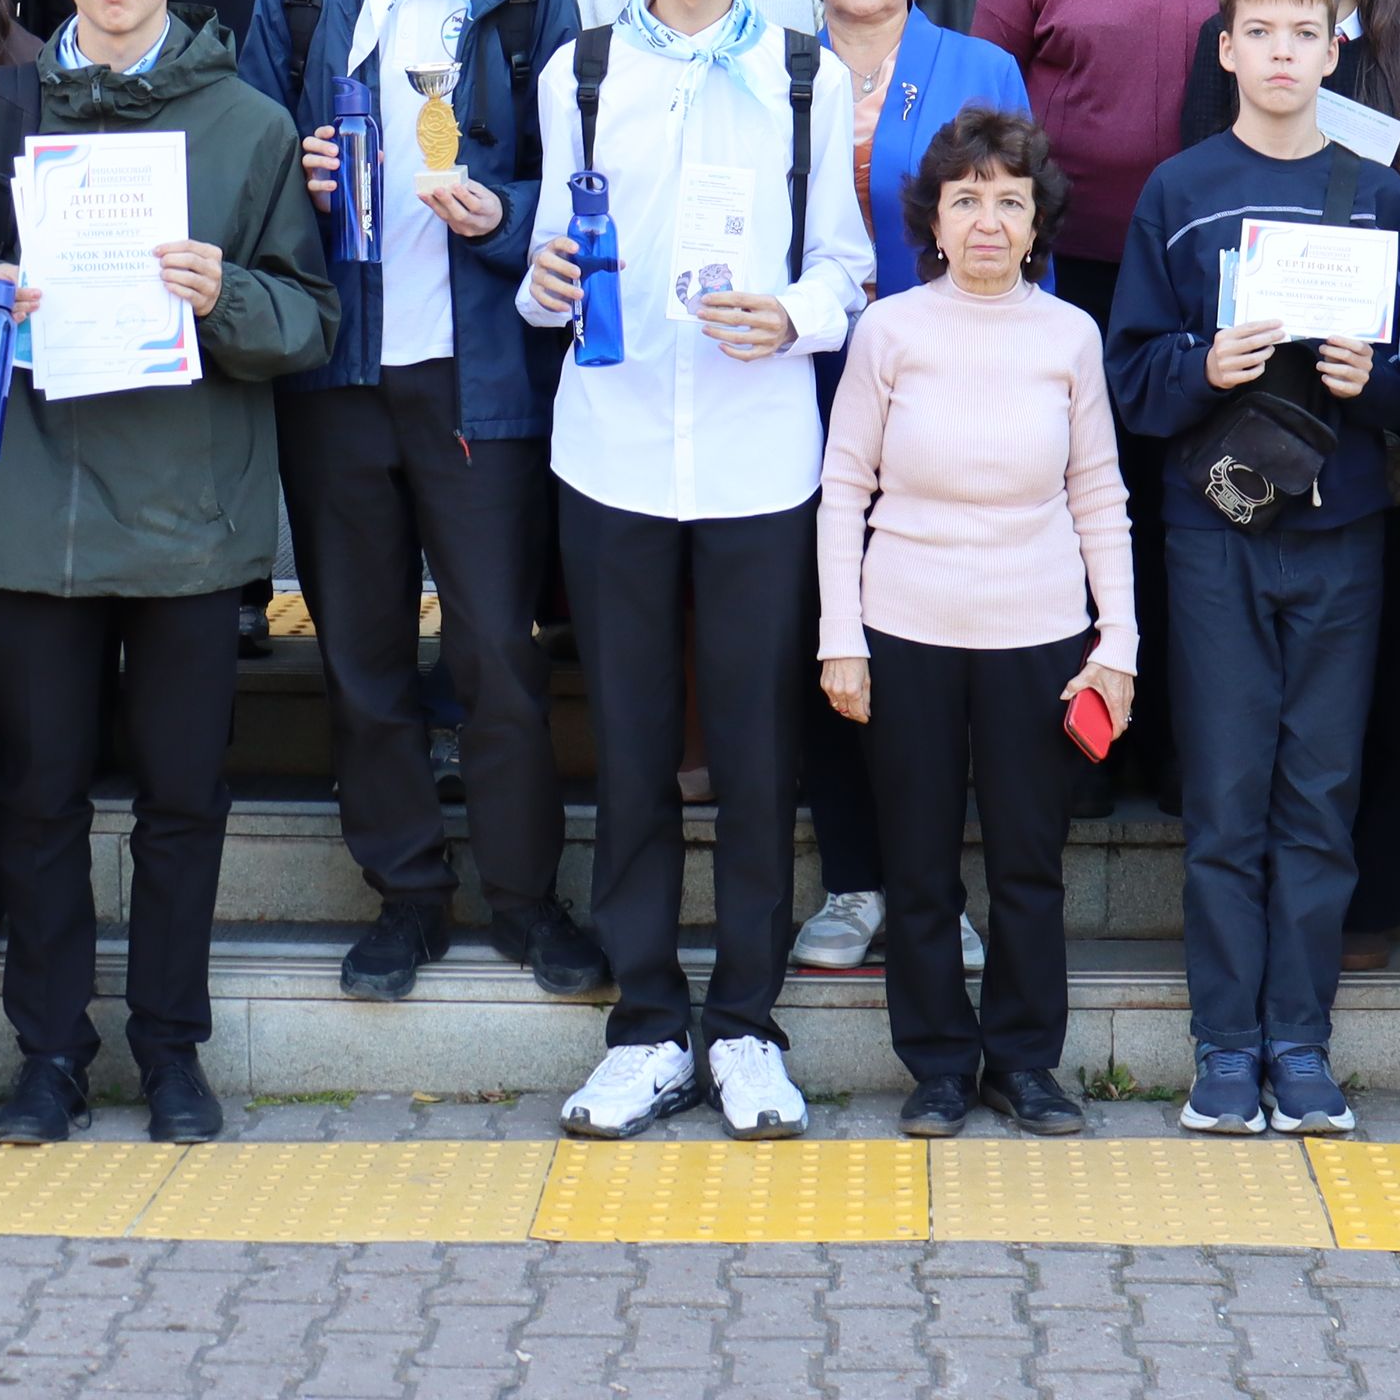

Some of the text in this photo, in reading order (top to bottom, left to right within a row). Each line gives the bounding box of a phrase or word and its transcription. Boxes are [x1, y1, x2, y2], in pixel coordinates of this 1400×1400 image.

[70, 192, 144, 206] ДИПЛОМ
[75, 207, 152, 219] СТЕПЕНИ
[1277, 259, 1360, 274] СЕРТИФИКАТ
